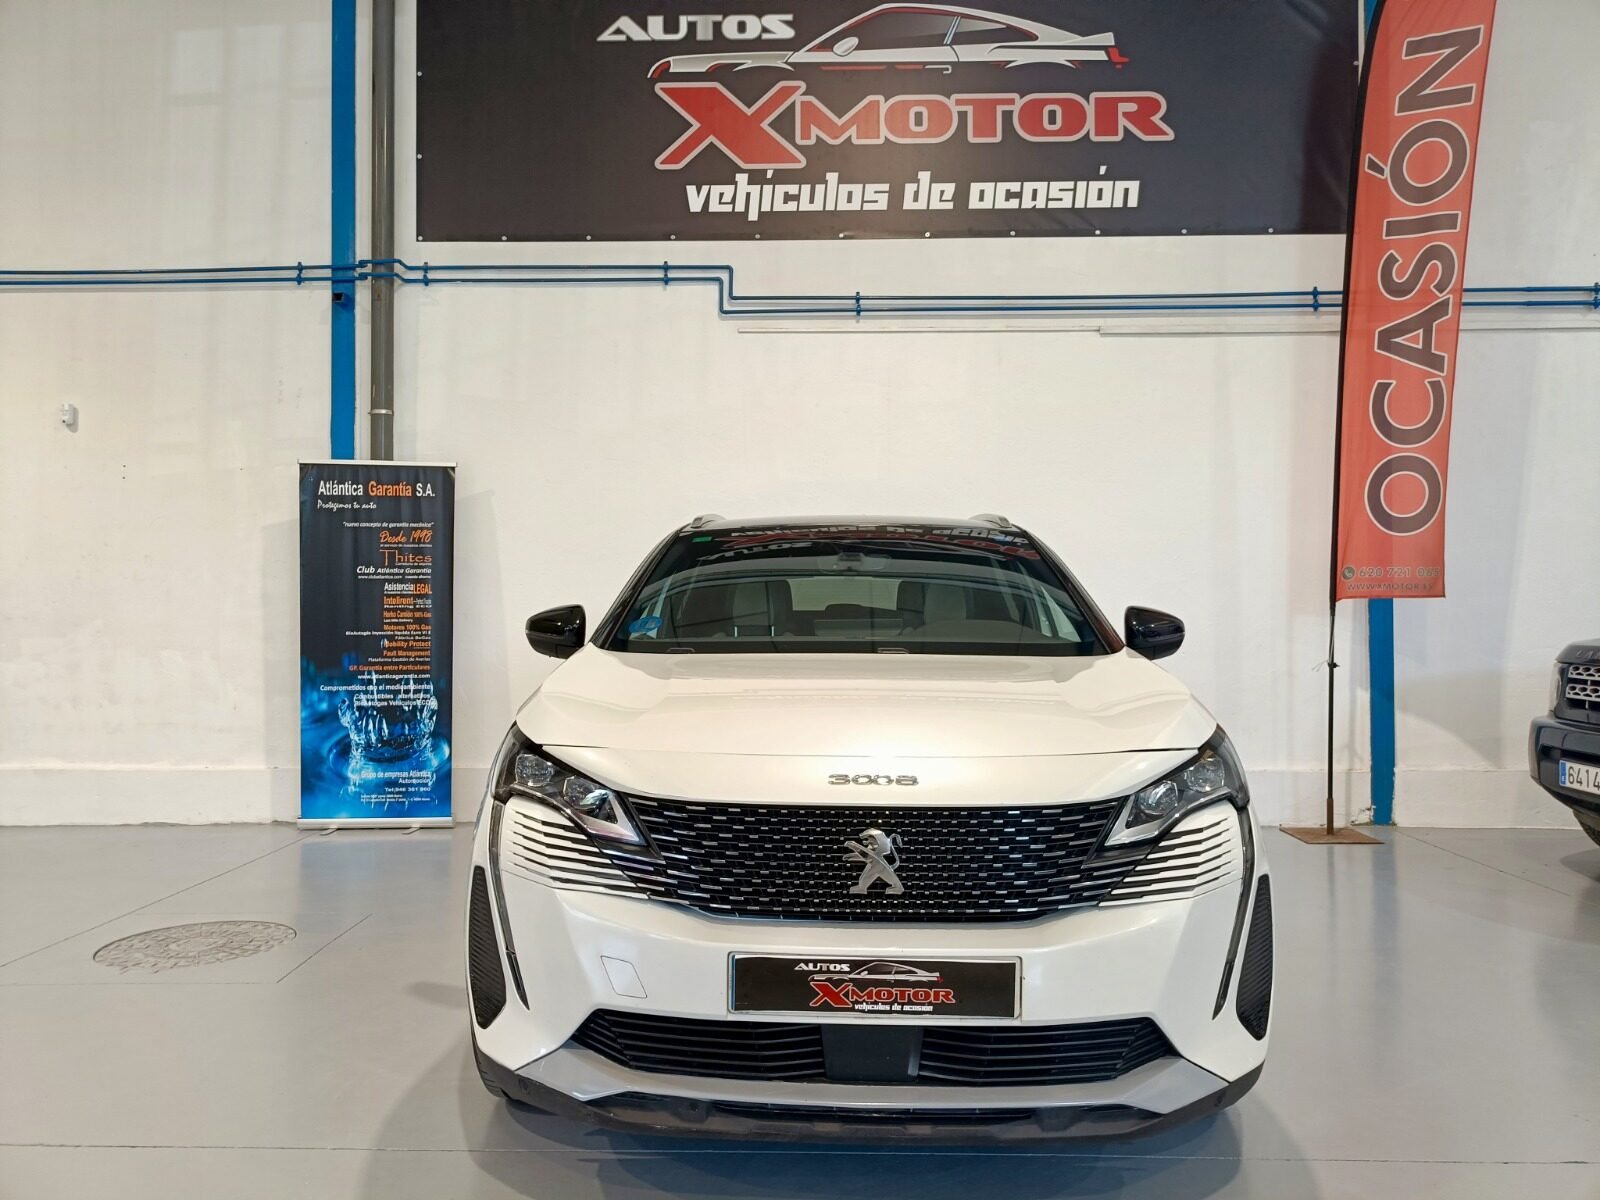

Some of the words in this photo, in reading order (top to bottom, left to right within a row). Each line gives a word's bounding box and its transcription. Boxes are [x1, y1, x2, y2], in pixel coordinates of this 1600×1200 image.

[596, 14, 796, 41] AUTOS
[686, 169, 890, 222] vehículos
[902, 170, 956, 210] de
[968, 165, 1141, 210] ocasión
[1364, 24, 1484, 536] OCASIÓN
[318, 480, 363, 496] Atlántica
[368, 481, 412, 497] Garantía
[416, 483, 436, 497] S.A.
[317, 499, 352, 512] Protegemos
[379, 530, 408, 543] Desde
[410, 529, 433, 543] 1998
[356, 566, 376, 574] Club
[828, 774, 919, 786] 3008
[1568, 766, 1600, 791] 6414
[794, 962, 851, 972] AUTOS
[891, 1003, 901, 1011] de
